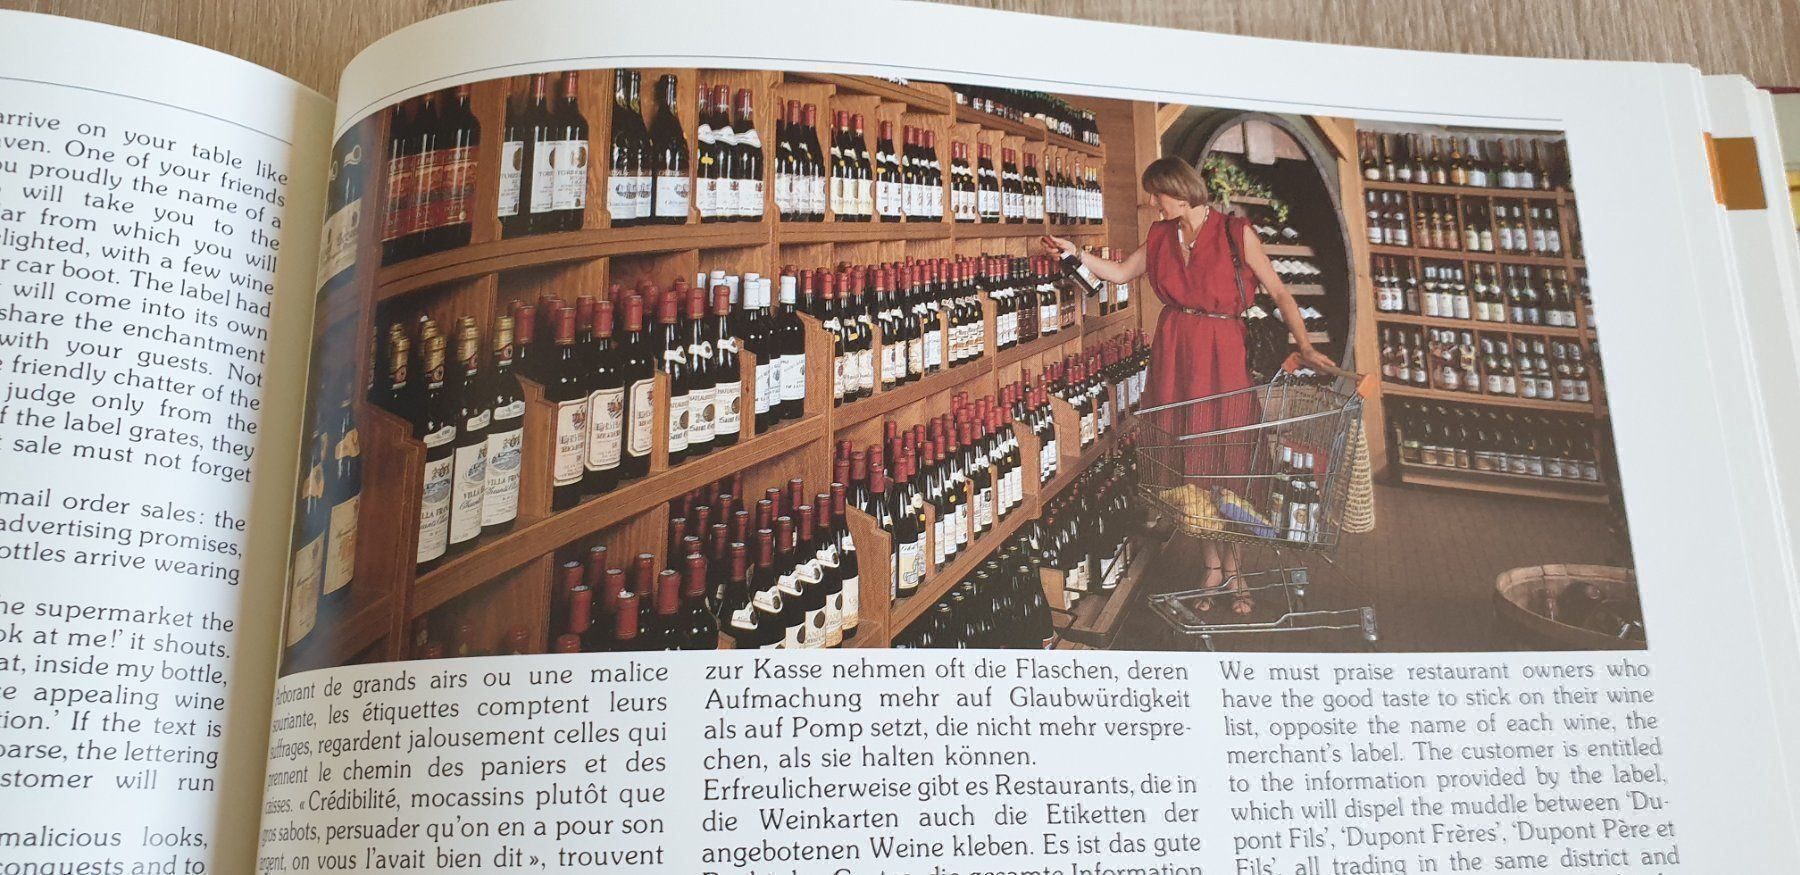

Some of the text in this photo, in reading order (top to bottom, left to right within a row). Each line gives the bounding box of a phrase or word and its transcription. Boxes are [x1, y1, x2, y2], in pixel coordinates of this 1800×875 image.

[0, 112, 288, 185] arrive on your table like
[0, 137, 285, 207] ven. One of your friends
[29, 164, 122, 190] proudly
[133, 176, 168, 196] the
[178, 189, 237, 213] name
[246, 207, 265, 222] of
[272, 217, 281, 229] a
[40, 208, 96, 231] from
[113, 221, 180, 247] which
[194, 240, 231, 259] you
[246, 253, 277, 273] will
[16, 260, 55, 275] car
[63, 259, 119, 284] boot.
[130, 269, 173, 293] The
[180, 279, 230, 306] label
[236, 292, 271, 318] had
[0, 331, 263, 387] with your guests. Not
[4, 382, 257, 434] judge only from the
[0, 488, 245, 531] mail order sales: the
[0, 542, 240, 585] ottles arrive wearing
[33, 628, 58, 645] at
[130, 633, 145, 650] it
[153, 633, 229, 658] shouts.
[324, 676, 342, 697] de
[353, 670, 416, 699] grands
[430, 670, 467, 689] airs
[483, 672, 511, 686] ou
[529, 670, 572, 685] une
[591, 661, 668, 683] malice
[705, 657, 1188, 683] zur Kasse nehmen oft die Flaschen, deren
[1219, 658, 1650, 685] We must praise restaurant owners who
[328, 704, 349, 724] les
[362, 701, 459, 725] étiquettes
[477, 694, 589, 720] comptent
[610, 691, 667, 712] leurs
[1221, 685, 1654, 712] have the good taste to stick on their wine
[71, 711, 91, 731] If
[102, 712, 141, 732] the
[154, 717, 197, 736] text
[207, 720, 221, 737] is
[318, 730, 401, 757] regardent
[407, 726, 545, 754] jalousement
[554, 721, 619, 744] celles
[629, 722, 666, 746] qui
[704, 715, 1191, 742] als auf Pomp setzt, die nicht mehr verspre-
[703, 745, 1036, 773] chen, als sie halten können.
[1350, 742, 1405, 762] label.
[1412, 741, 1453, 760] The
[1461, 743, 1554, 760] customer
[1562, 741, 1579, 757] is
[1587, 736, 1663, 757] entitled
[1228, 763, 1669, 792] to the information provided by the label,
[308, 788, 400, 812] Crédibilité,
[411, 787, 524, 807] mocassins
[536, 783, 607, 810] plutôt
[619, 787, 665, 808] que
[702, 802, 1199, 832] die Weinkarten auch die Etiketten der
[0, 825, 207, 849] malicious looks,
[702, 832, 1200, 867] angebotenen Weine kleben. Es ist das gute
[1233, 831, 1282, 855] pont
[1602, 819, 1650, 839] Père
[1656, 821, 1676, 840] et
[292, 856, 309, 870] on
[318, 855, 356, 870] vous
[437, 846, 481, 868] bien
[494, 845, 523, 867] dit
[558, 845, 664, 866] trouvent
